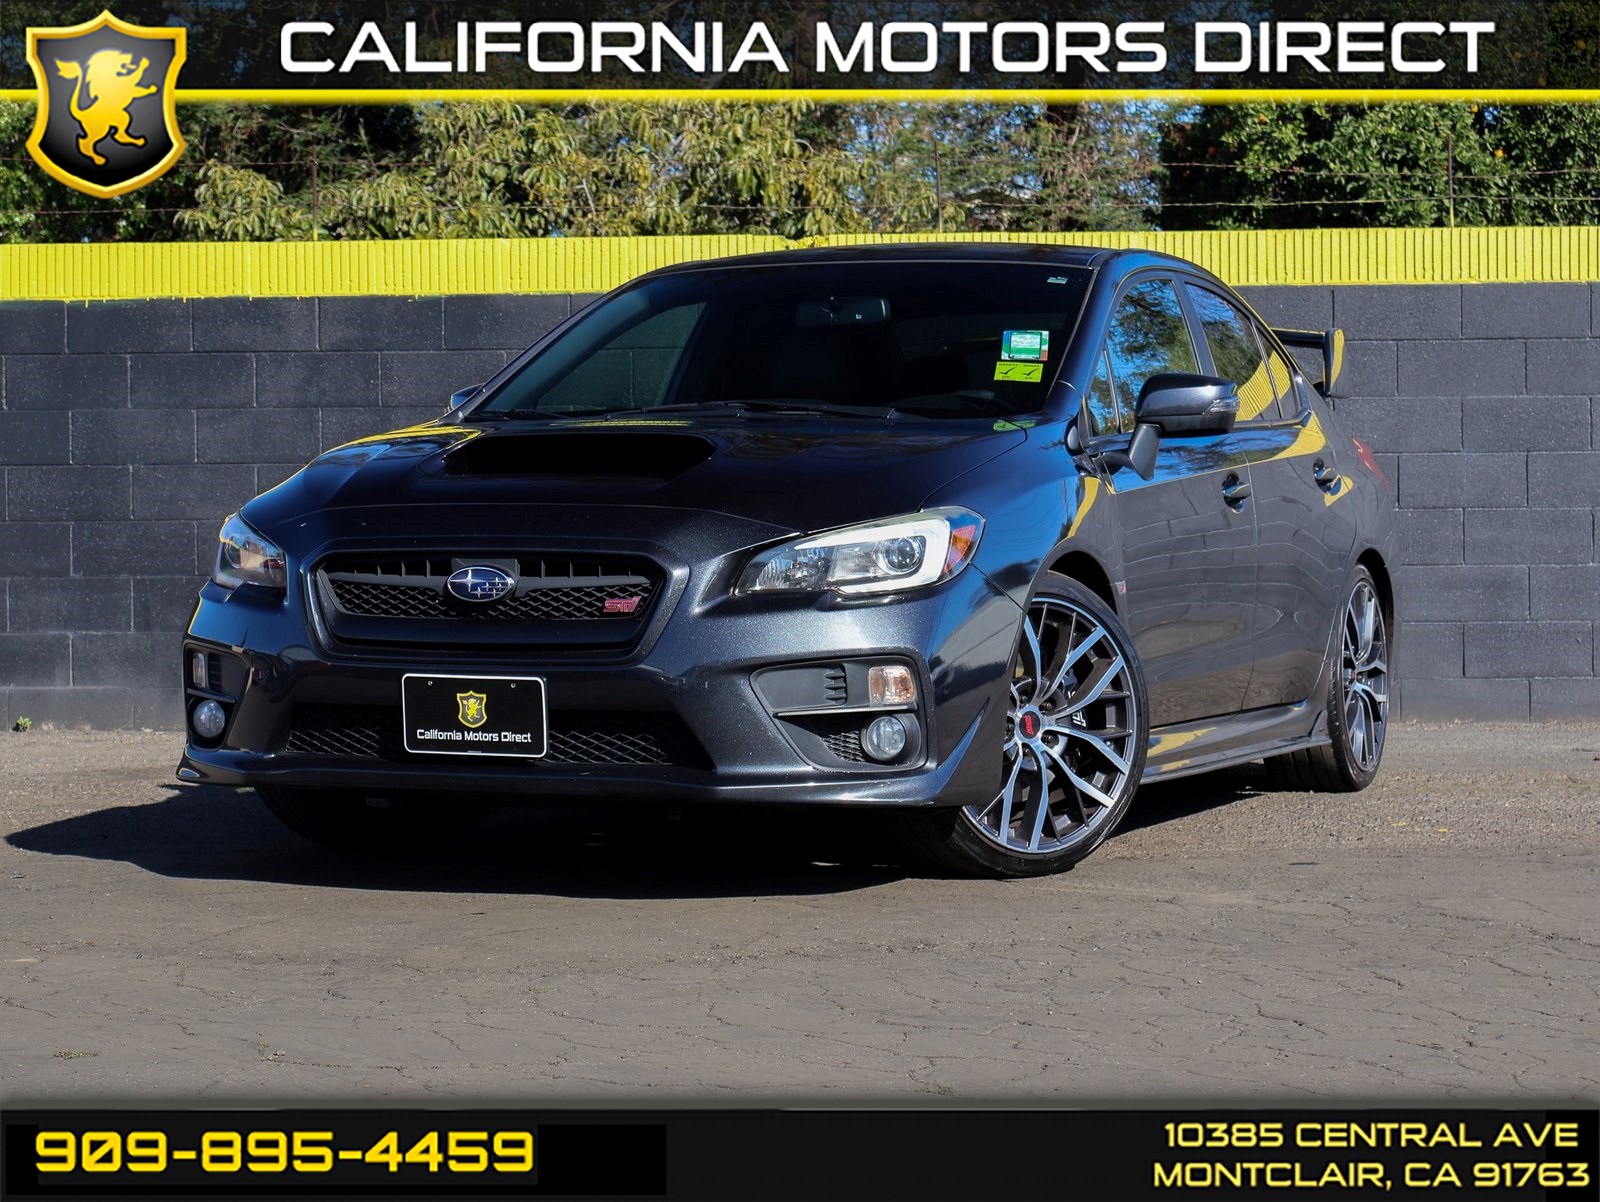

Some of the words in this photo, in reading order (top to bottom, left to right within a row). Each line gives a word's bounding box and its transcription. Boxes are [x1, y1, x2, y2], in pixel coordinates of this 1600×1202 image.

[416, 728, 463, 741] California
[464, 730, 499, 742] Motors
[501, 732, 532, 743] Direct
